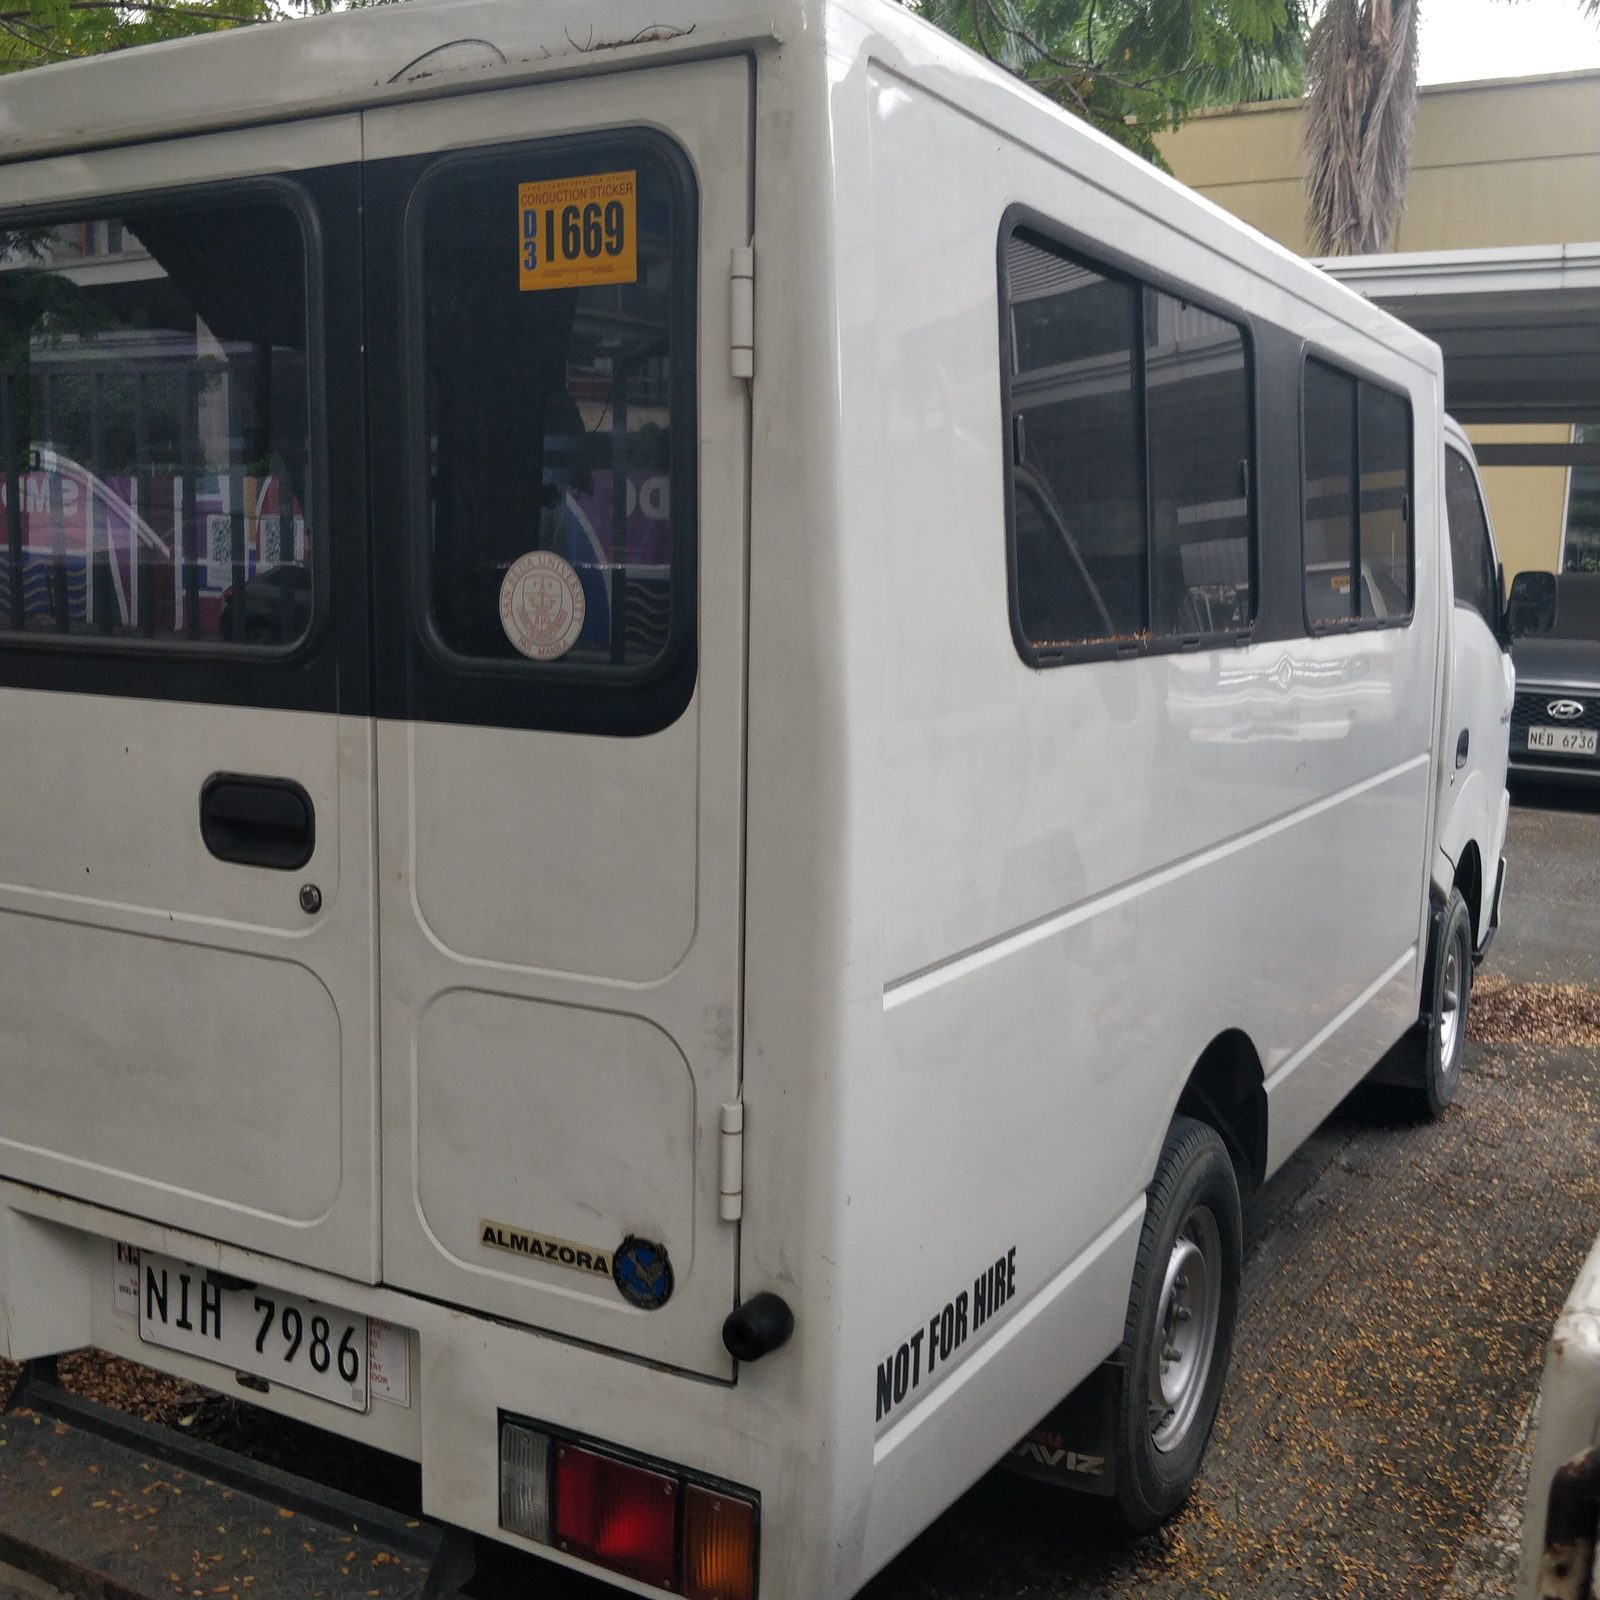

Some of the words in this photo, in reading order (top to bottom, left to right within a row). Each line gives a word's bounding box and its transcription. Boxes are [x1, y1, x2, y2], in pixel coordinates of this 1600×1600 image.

[521, 188, 587, 206] CONDUCTION
[590, 182, 633, 199] STICKER
[1562, 734, 1594, 749] 6736
[482, 1226, 610, 1274] ALMAZORA
[147, 1265, 222, 1340] NIH
[253, 1296, 360, 1383] 7986
[876, 1327, 925, 1423] NOT
[928, 1290, 969, 1374] FOR
[973, 1245, 1017, 1332] HIRE
